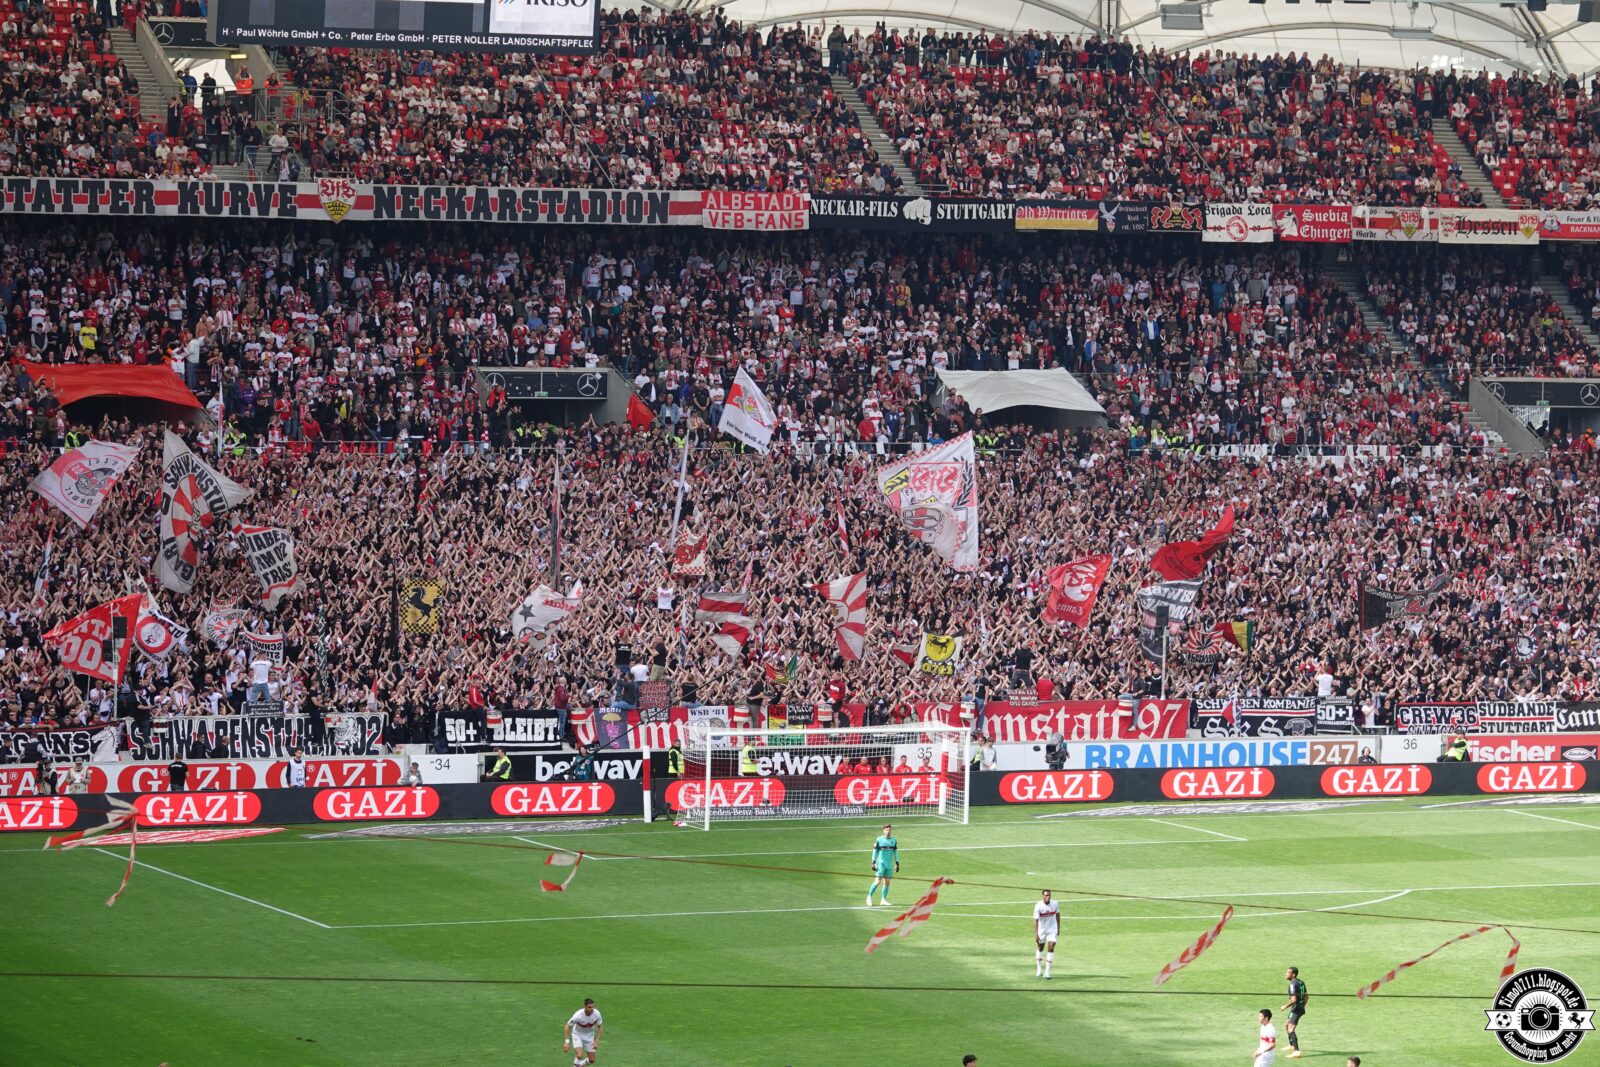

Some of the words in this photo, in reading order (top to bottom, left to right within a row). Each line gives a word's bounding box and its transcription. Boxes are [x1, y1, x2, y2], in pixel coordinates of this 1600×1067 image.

[236, 29, 256, 37] Paul
[258, 29, 289, 38] Wöhrle
[291, 31, 318, 39] GmbH
[328, 32, 343, 40] Co.
[351, 33, 373, 41] Peter
[376, 34, 395, 42] Erbe
[398, 34, 424, 43] GmbH
[432, 36, 462, 44] PETER
[464, 37, 500, 45] NOLLER
[0, 179, 155, 215] TATTER
[177, 183, 298, 217] KURVE
[373, 187, 671, 223] NECKARSTADION
[706, 193, 804, 210] ALBSTADT
[810, 199, 898, 217] NECKAR-FILS
[936, 203, 1015, 220] STUTTGART
[1205, 205, 1242, 217] Brigada
[1302, 208, 1348, 222] Suebia
[708, 214, 805, 230] VFB-FANS
[1455, 216, 1517, 239] Hessen
[1300, 224, 1350, 241] Ehingen
[1263, 698, 1315, 709] KOMPANIE
[1137, 702, 1182, 741] 97
[1316, 705, 1355, 721] 50+1
[1399, 708, 1449, 726] CREW
[1454, 706, 1477, 725] 36
[1479, 721, 1554, 733] STUTTGART
[353, 715, 382, 757] 02
[1403, 739, 1418, 750] 36
[918, 748, 932, 759] 35
[1085, 741, 1307, 769] BRAINHOUSE
[1313, 742, 1357, 765] 247
